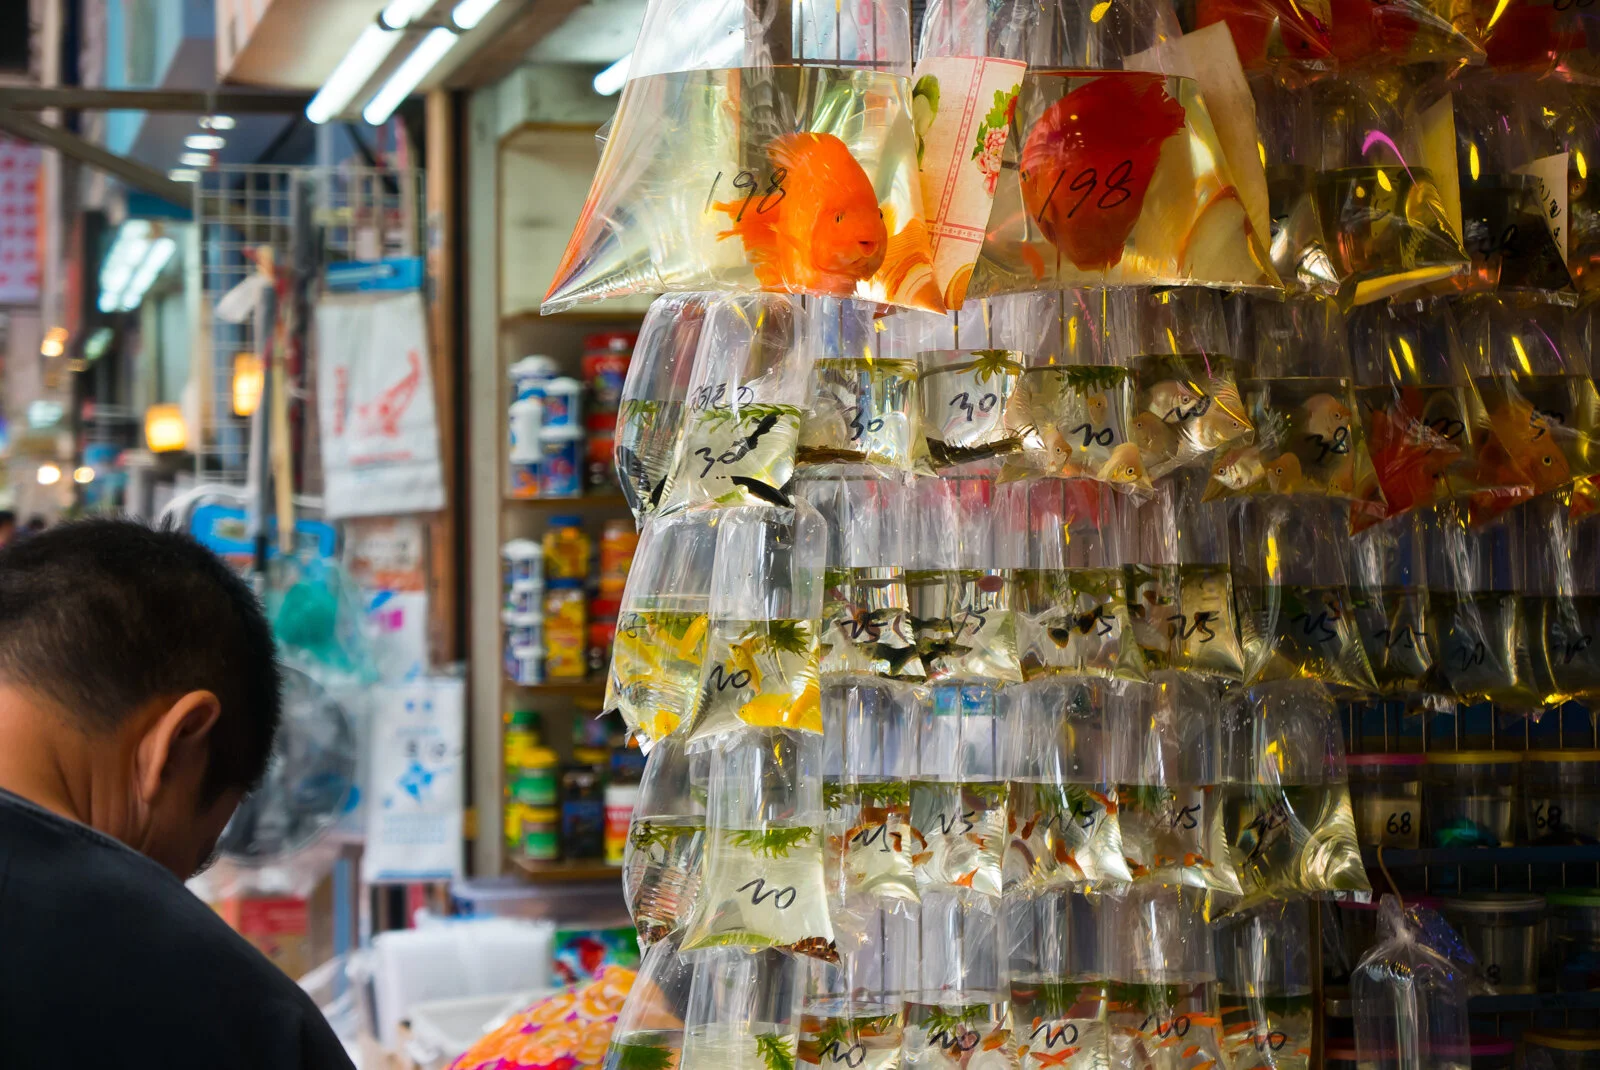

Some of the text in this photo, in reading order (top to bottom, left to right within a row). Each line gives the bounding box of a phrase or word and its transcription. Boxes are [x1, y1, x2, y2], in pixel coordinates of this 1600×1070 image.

[704, 167, 788, 222] 198
[1038, 160, 1134, 223] 198
[950, 392, 997, 422] 30
[847, 407, 884, 441] 30
[695, 446, 747, 478] 30
[1167, 612, 1219, 643] 25
[709, 665, 752, 691] 20
[1386, 811, 1412, 834] 68
[736, 877, 797, 909] 20
[928, 1030, 981, 1051] 20
[1029, 1023, 1078, 1048] 20
[1138, 1013, 1190, 1038] 20
[819, 1041, 867, 1068] 20
